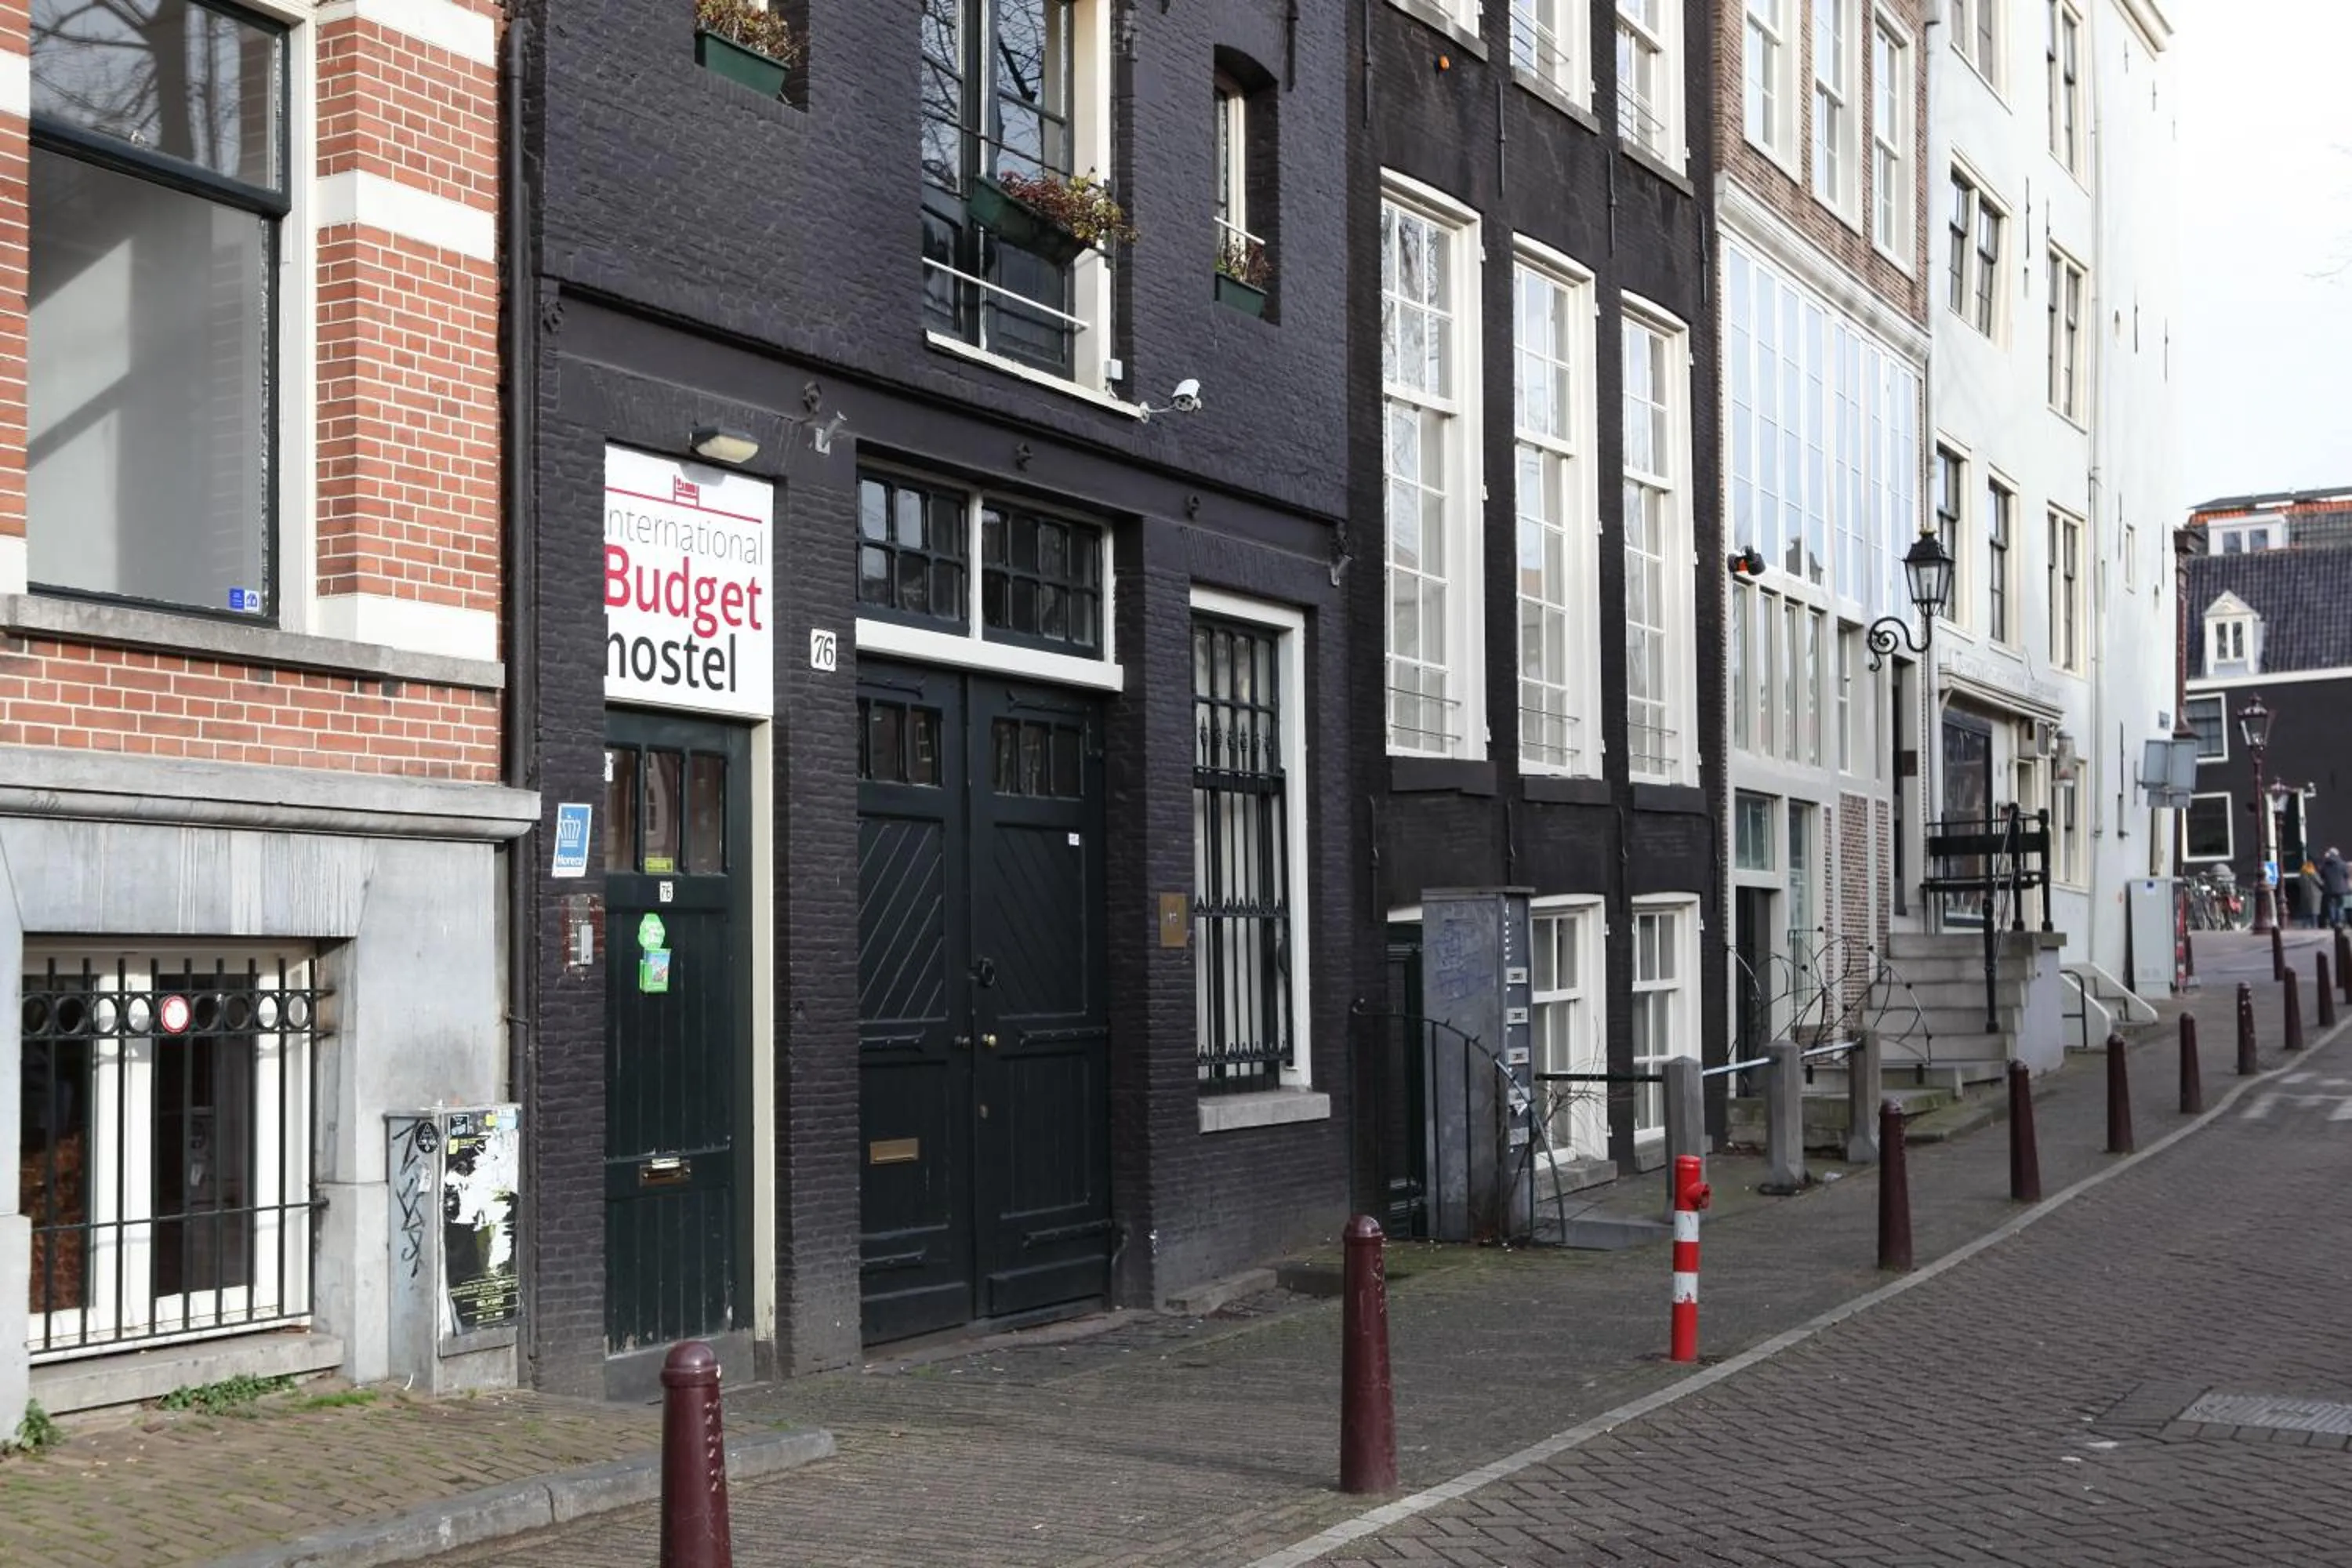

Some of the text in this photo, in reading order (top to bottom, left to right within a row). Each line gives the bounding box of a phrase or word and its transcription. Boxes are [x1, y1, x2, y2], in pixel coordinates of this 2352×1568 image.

[608, 508, 764, 565] nternational
[604, 543, 762, 639] Budget
[604, 613, 736, 693] hostel
[815, 634, 834, 666] 76
